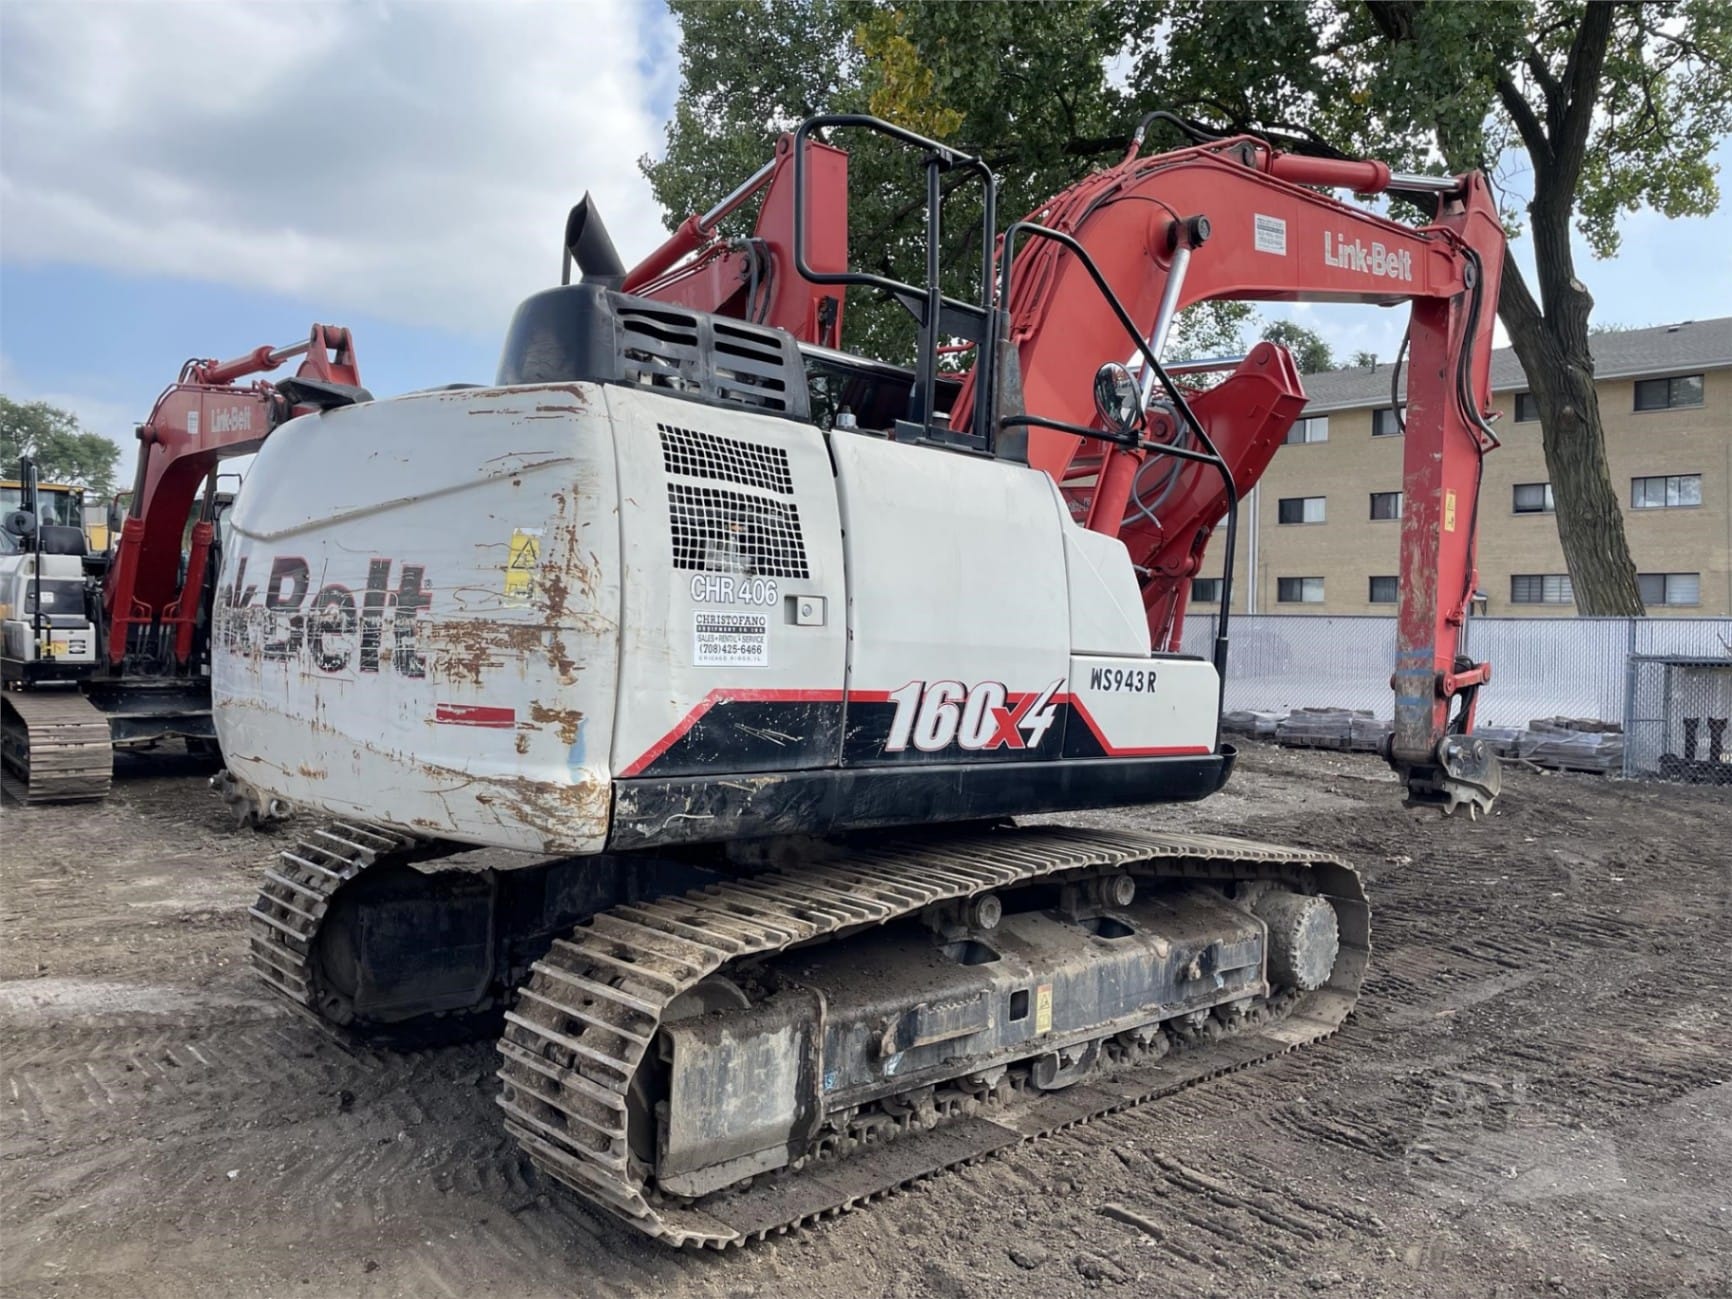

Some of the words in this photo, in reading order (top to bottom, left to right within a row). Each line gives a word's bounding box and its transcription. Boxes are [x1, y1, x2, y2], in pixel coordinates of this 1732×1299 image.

[1324, 230, 1412, 282] Link-Belt
[691, 574, 735, 604] CHR
[738, 578, 778, 606] 406
[696, 614, 766, 626] CHRISTOFANO
